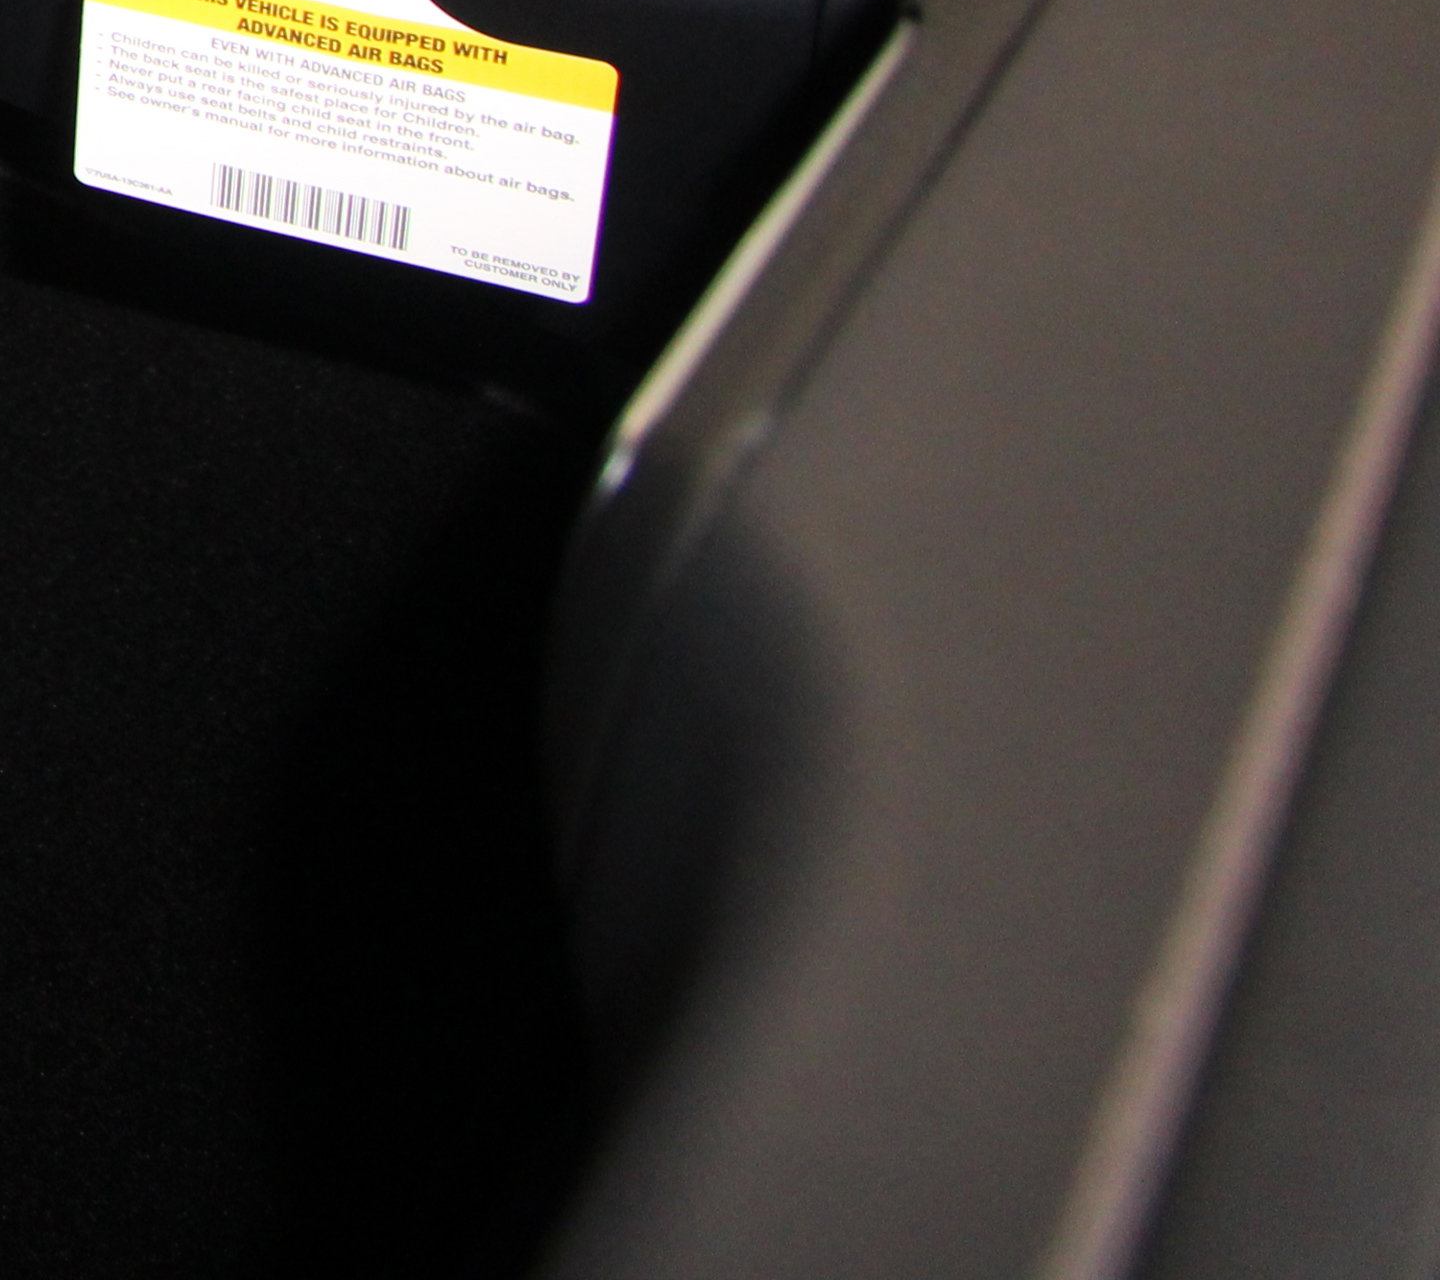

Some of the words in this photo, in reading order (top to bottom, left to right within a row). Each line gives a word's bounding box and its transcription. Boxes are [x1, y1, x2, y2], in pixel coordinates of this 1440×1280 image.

[211, 37, 250, 56] EVEN
[255, 47, 294, 67] WITH
[300, 59, 383, 86] ADVANCED
[389, 78, 416, 93] AIR
[422, 84, 466, 103] BAGS
[237, 17, 341, 53] ADVANCED
[347, 43, 382, 62] AIR
[389, 50, 444, 74] BAGS
[320, 14, 339, 31] IS
[346, 20, 446, 52] EQUIPPED
[452, 41, 508, 65] WITH
[108, 73, 163, 94] Always
[168, 88, 195, 102] use
[200, 95, 233, 111] seat
[238, 103, 277, 122] belts
[282, 115, 312, 130] and
[317, 123, 357, 140] child
[363, 134, 447, 159] restraints.
[109, 59, 153, 77] Never
[158, 70, 183, 86] put
[188, 79, 197, 88] a
[202, 82, 232, 96] rear
[237, 90, 286, 112] facing
[292, 104, 332, 120] child
[336, 114, 371, 128] seat
[377, 120, 391, 132] in
[397, 125, 423, 139] the
[429, 132, 474, 151] front.
[111, 32, 176, 55] Children
[181, 48, 208, 62] can
[214, 55, 232, 68] be
[238, 61, 280, 80] killed
[286, 75, 302, 85] or
[307, 80, 383, 105] seriously
[389, 94, 448, 116] injured
[454, 108, 475, 123] by
[481, 114, 508, 128] the
[513, 121, 536, 134] air
[541, 126, 580, 145] bag.
[111, 45, 138, 60] The
[143, 53, 179, 70] back
[184, 63, 217, 79] seat
[222, 71, 235, 83] is
[241, 75, 265, 90] the
[271, 83, 319, 104] safest
[324, 98, 369, 114] place
[375, 106, 397, 119] for
[403, 112, 480, 138] Children.
[107, 85, 135, 101] See
[140, 95, 200, 117] owner's
[205, 110, 262, 132] manual
[268, 124, 290, 138] for
[296, 133, 337, 149] more
[342, 142, 439, 171] information
[444, 165, 494, 183] about
[498, 176, 521, 189] air
[527, 181, 575, 201] bags.
[450, 245, 468, 256] TO
[471, 250, 489, 261] BE
[492, 255, 558, 278] REMOVED
[561, 271, 580, 283] BY
[464, 259, 538, 283] CUSTOMER
[541, 277, 577, 292] ONLY
